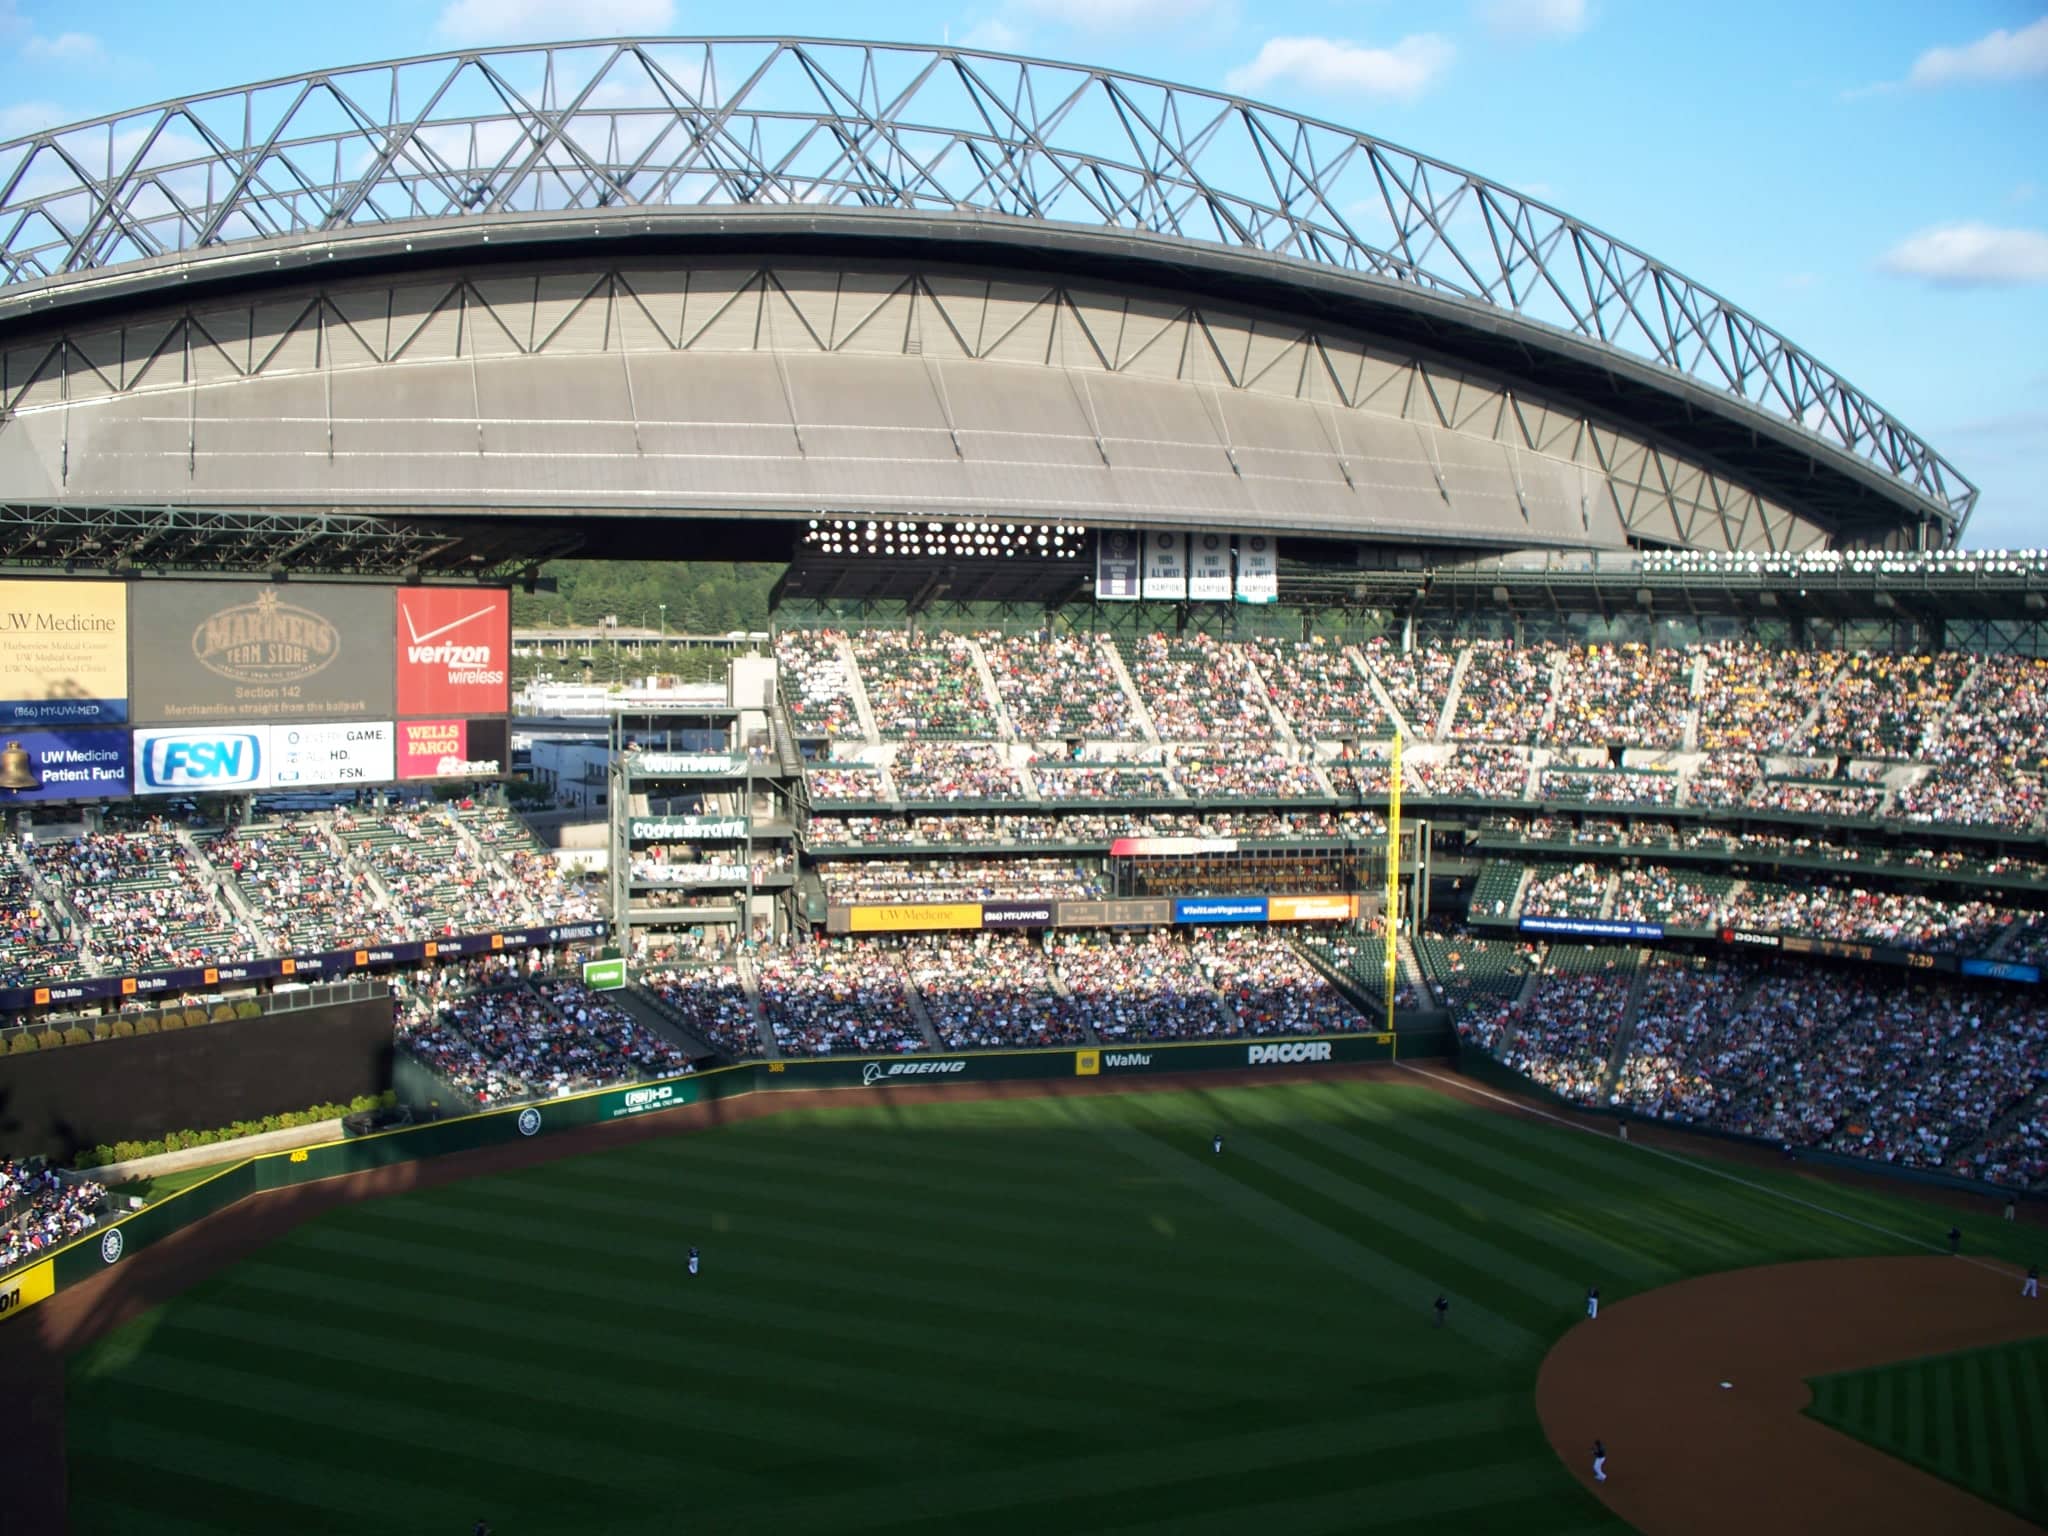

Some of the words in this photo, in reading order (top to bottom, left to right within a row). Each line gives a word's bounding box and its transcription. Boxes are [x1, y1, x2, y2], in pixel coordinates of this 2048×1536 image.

[36, 614, 116, 632] Medicine
[205, 613, 331, 654] MARINERS
[226, 644, 261, 664] TEAM
[268, 643, 308, 663] STORE
[408, 640, 490, 668] verizon
[448, 669, 504, 685] wireless
[235, 687, 279, 699] Section
[283, 686, 301, 697] 142
[164, 703, 236, 716] Merchandise
[239, 701, 280, 715] straight
[281, 701, 304, 713] from
[307, 701, 324, 713] the
[326, 700, 366, 713] ballpark
[346, 730, 387, 742] GAME.
[406, 724, 459, 740] WELLS
[407, 740, 459, 755] FARGO
[41, 751, 64, 764] UW
[66, 750, 119, 763] Medicine
[162, 741, 244, 782] FSN
[644, 756, 731, 772] COUNTDOWN
[42, 767, 89, 783] Patient
[92, 766, 125, 780] Fund
[633, 821, 747, 838] COOPERSTOWN
[879, 911, 900, 921] UW
[903, 909, 953, 921] Medicine
[559, 925, 594, 940] MARINERS
[1734, 931, 1779, 946] DODGE
[1105, 1053, 1150, 1067] WaMu
[1248, 1041, 1332, 1065] PACCAR
[888, 1060, 967, 1075] BOEING
[652, 1086, 673, 1100] HD
[290, 1150, 308, 1163] 405
